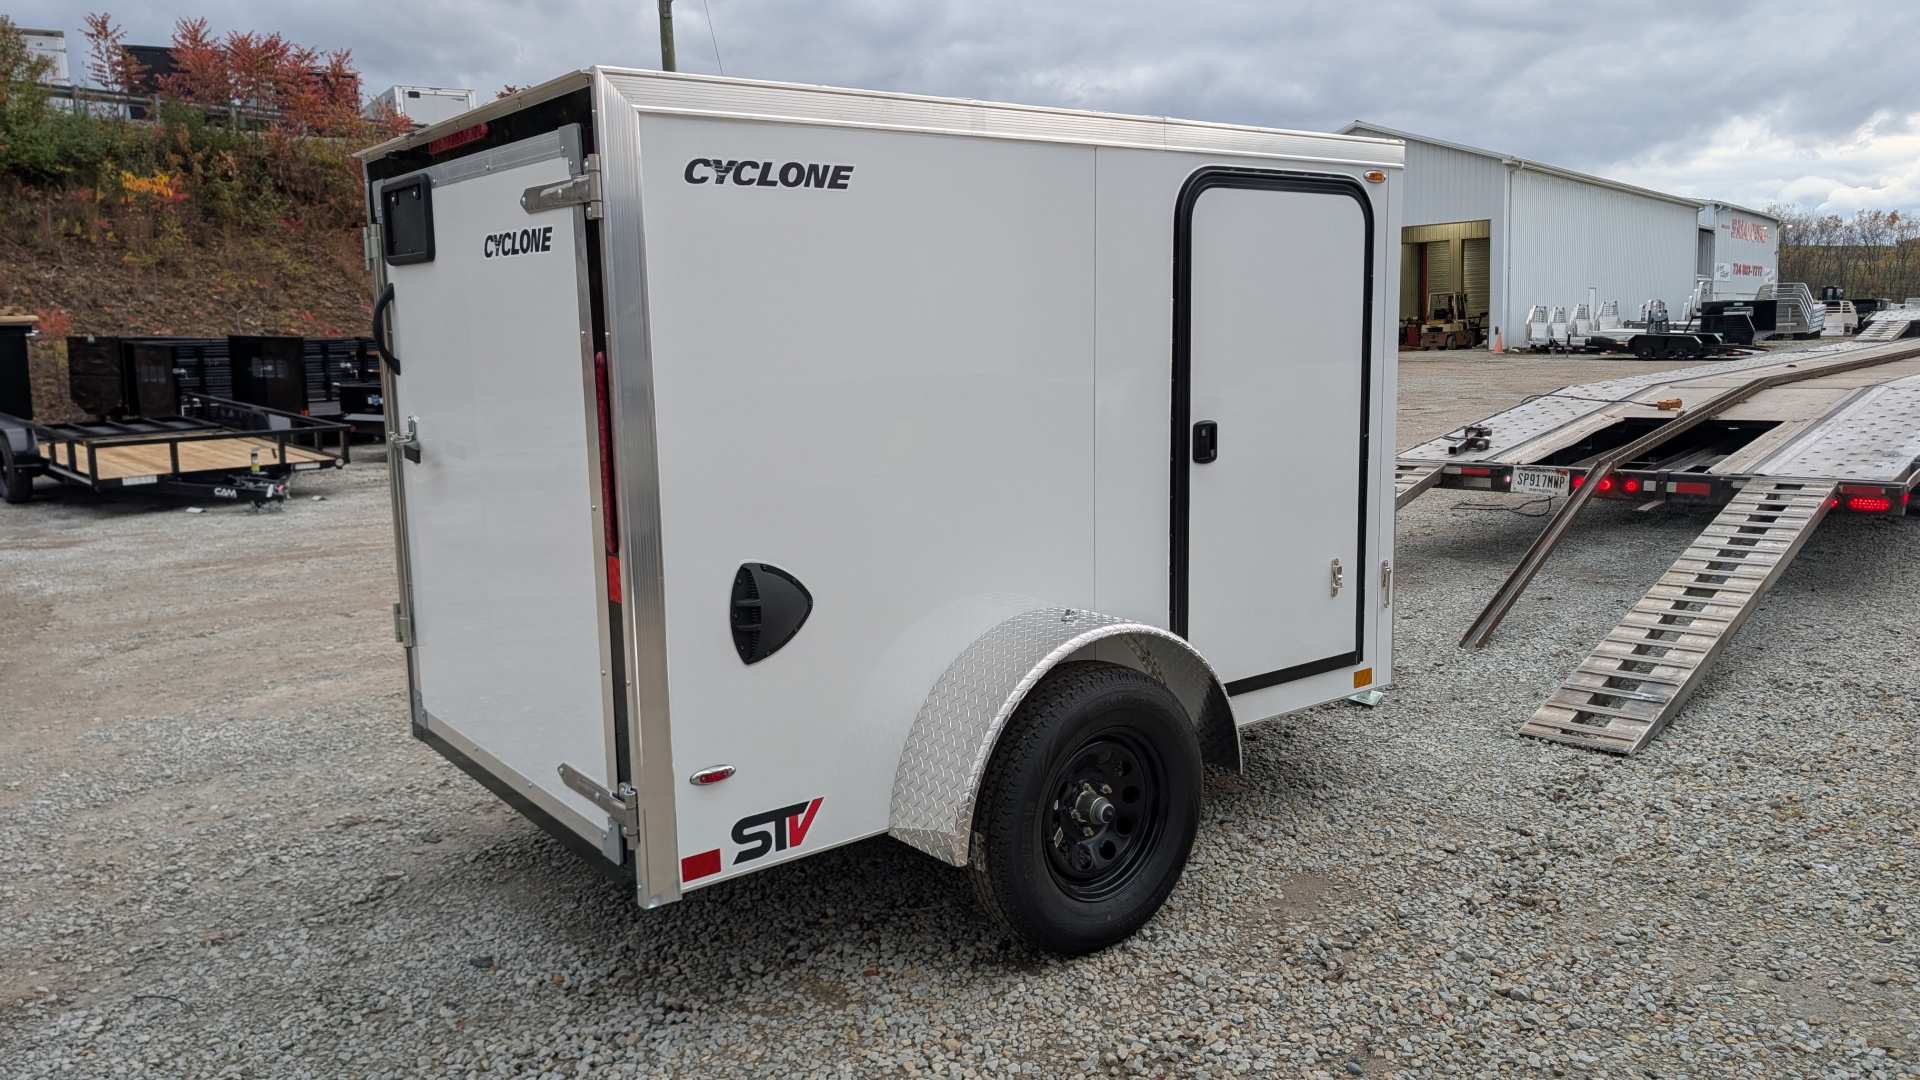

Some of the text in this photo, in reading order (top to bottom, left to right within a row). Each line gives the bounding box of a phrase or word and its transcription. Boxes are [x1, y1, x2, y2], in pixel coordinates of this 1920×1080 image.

[684, 157, 854, 190] CYCLONE
[484, 226, 553, 258] CYCLONE
[213, 487, 237, 497] CAM
[1517, 472, 1565, 489] SP917MWP
[731, 797, 824, 865] STV
